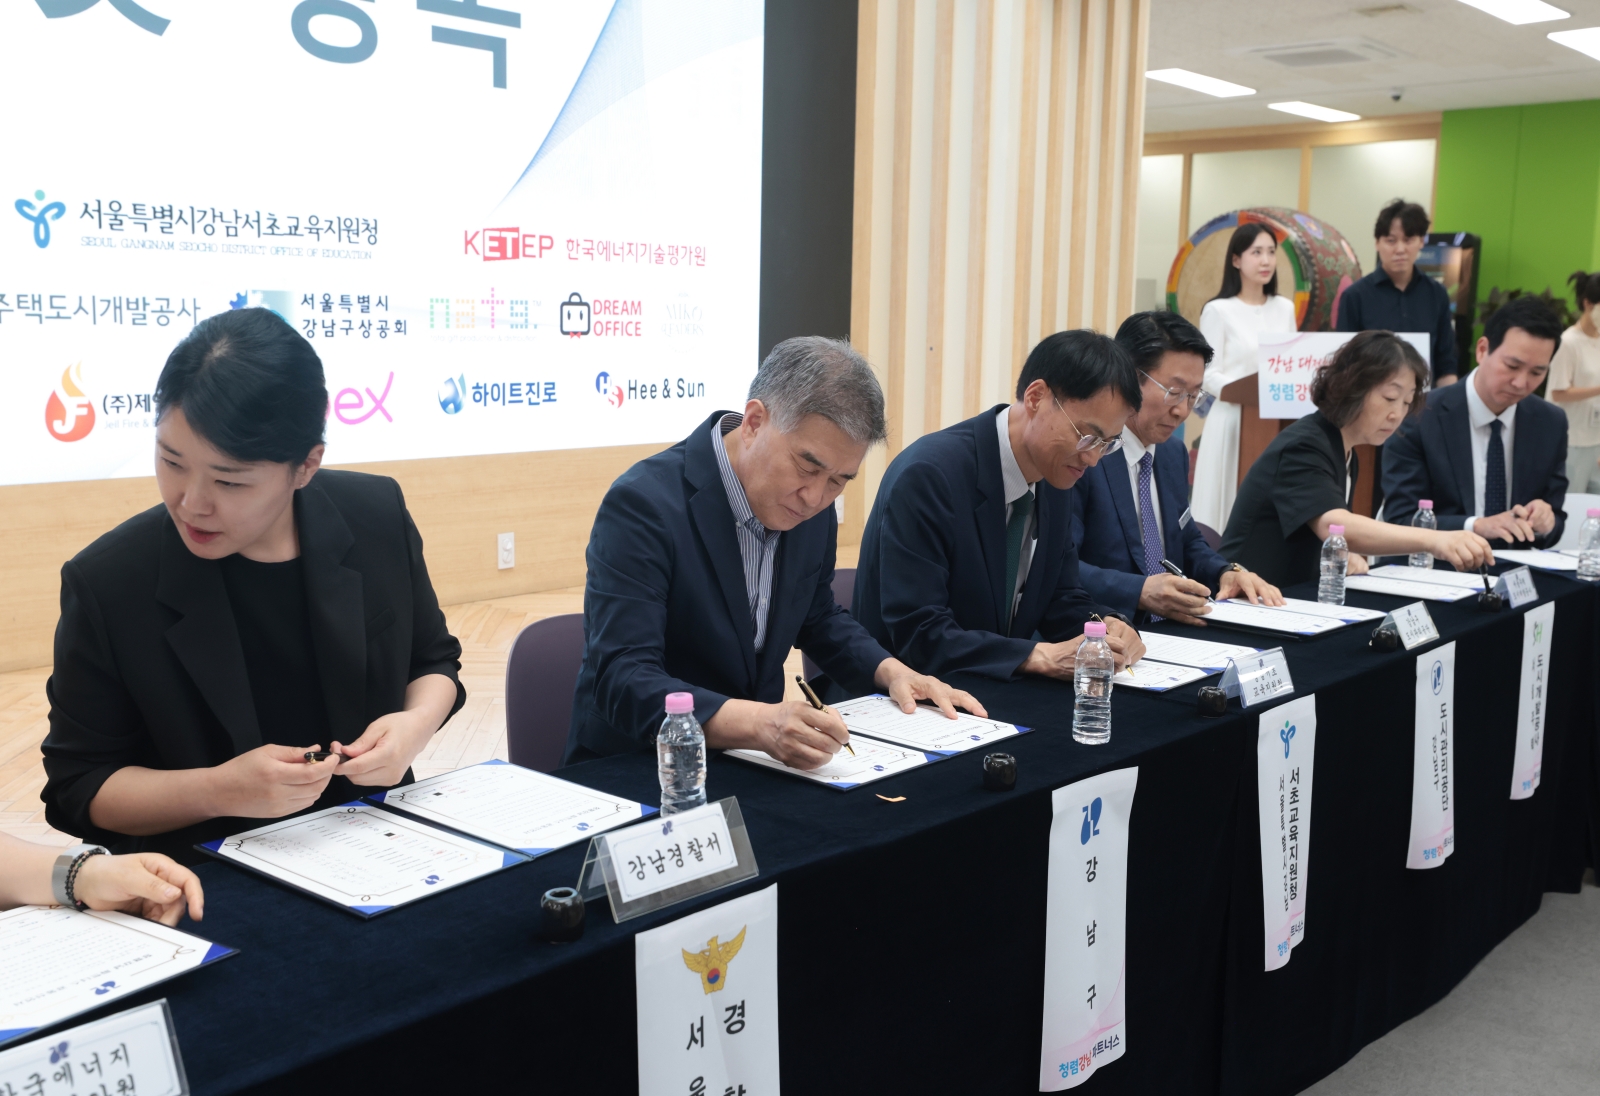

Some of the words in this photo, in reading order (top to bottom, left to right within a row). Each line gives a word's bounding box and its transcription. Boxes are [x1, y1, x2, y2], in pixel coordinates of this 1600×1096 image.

[80, 199, 378, 245] 서울특별시강남서초교육지원청
[81, 236, 117, 247] SEOUL
[121, 238, 175, 250] GANGNAM
[179, 241, 218, 252] SEOCHO
[222, 243, 266, 254] DISTRICT
[270, 246, 303, 256] OFFICE
[307, 248, 318, 257] OF
[322, 249, 372, 260] EDUCATION
[464, 228, 554, 261] KETEP
[566, 238, 706, 266] 한국에너지기술평가원
[301, 293, 389, 313] 서울특별시
[593, 299, 642, 316] DREAM
[302, 319, 408, 338] 강남구상공회
[593, 320, 642, 337] OFFICE
[1268, 354, 1293, 374] 강남
[325, 371, 394, 425] ex
[472, 381, 557, 406] 하이트진로
[628, 379, 657, 400] Hee
[662, 378, 671, 399] &
[677, 378, 704, 398] Sun
[1269, 383, 1312, 401] 청렴강
[1440, 702, 1449, 812] 도시관리공단
[1289, 766, 1300, 901] 서초교육지원청
[628, 832, 722, 881] 강남경찰서
[1085, 856, 1098, 1010] 강남구
